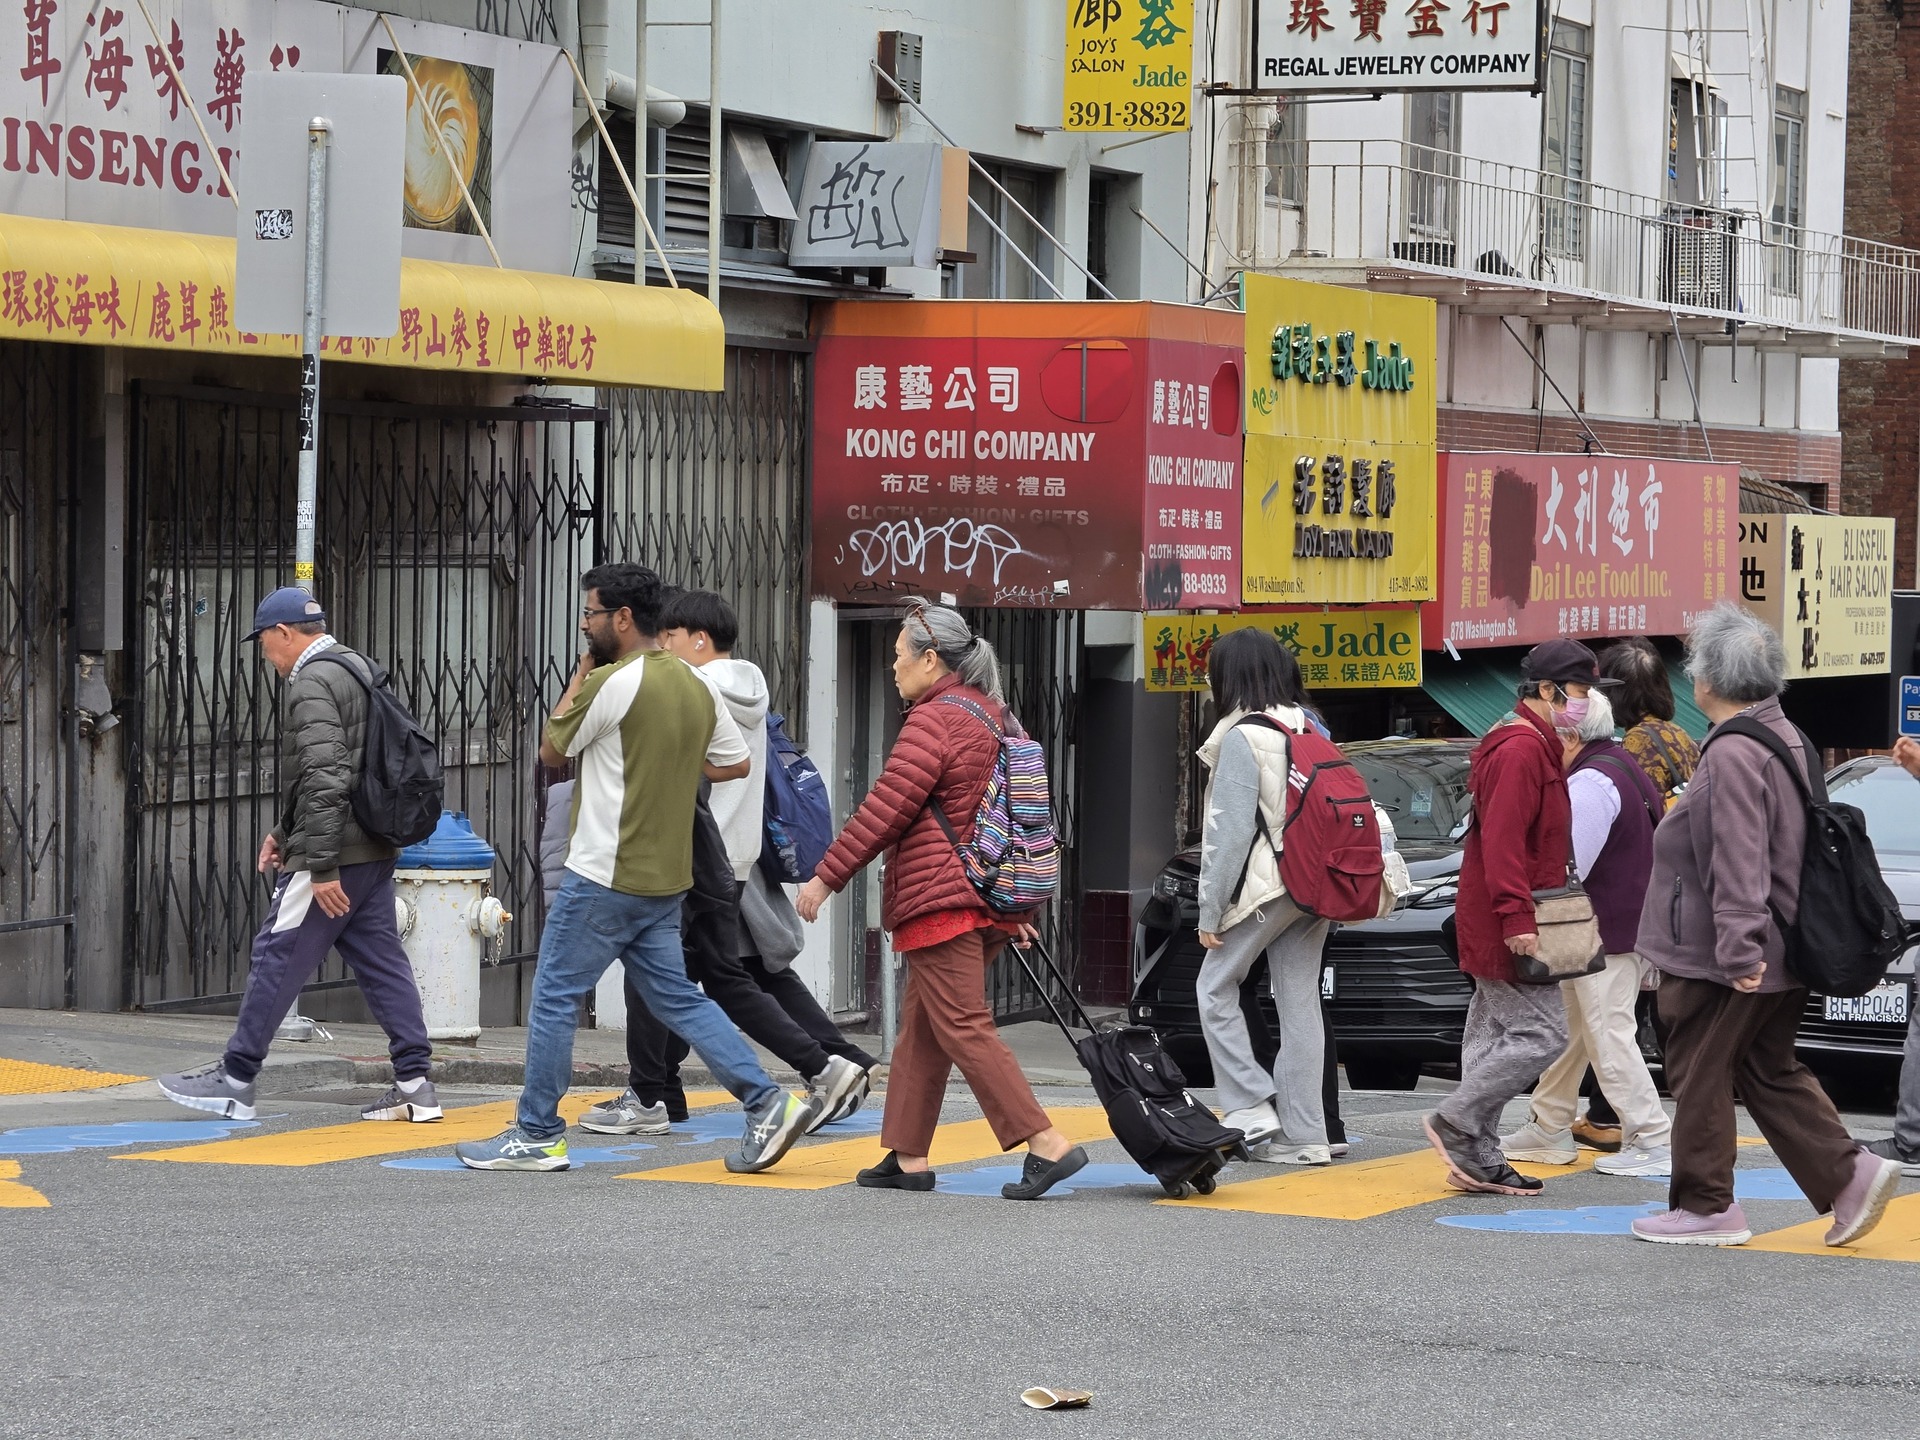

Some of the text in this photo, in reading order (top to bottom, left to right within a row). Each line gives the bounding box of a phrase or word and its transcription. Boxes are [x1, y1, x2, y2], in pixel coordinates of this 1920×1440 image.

[1079, 37, 1117, 55] JOY'S
[1071, 58, 1124, 73] SALON
[1133, 65, 1187, 87] Jade
[1264, 53, 1531, 77] REGAL JEWELRY COMPANY
[1069, 102, 1185, 127] 391-3832
[1362, 340, 1415, 391] Jade
[854, 364, 1019, 412] 康藝公司
[1152, 378, 1210, 430] 康藝公司
[846, 428, 1096, 461] KONG CHI COMPANY
[1149, 455, 1235, 490] KONG CHI COMPANY
[1542, 464, 1663, 560] 大利超市
[1324, 528, 1357, 558] HAIR
[1844, 528, 1887, 561] BLISSFUL
[1247, 576, 1305, 596] 894 Washington St.
[1531, 561, 1672, 601] Dai Lee Food Inc.
[1830, 565, 1887, 598] HAIR SALON
[1312, 623, 1411, 657] Jade
[1450, 617, 1517, 642] 878 Washington St.
[1904, 683, 1920, 697] Pa
[1825, 1013, 1907, 1023] SAN FRANCISCO
[1830, 995, 1904, 1015] 8EMP048
